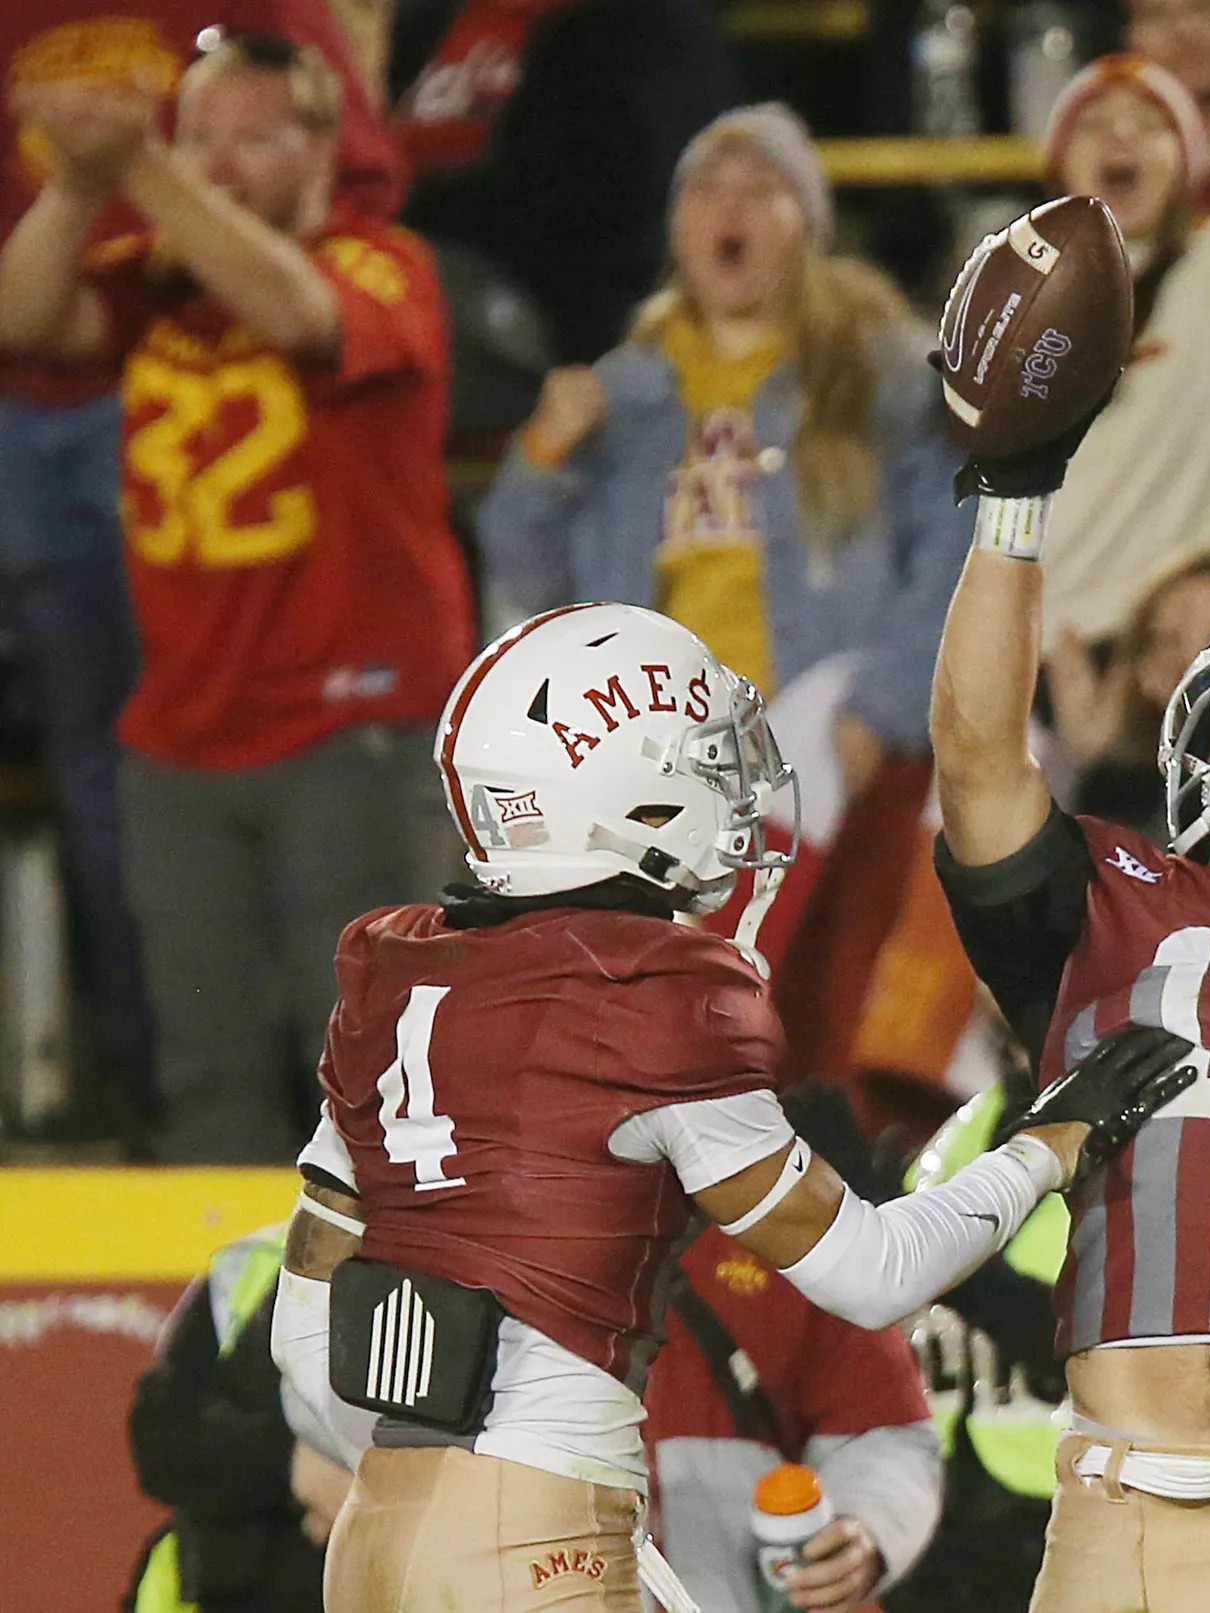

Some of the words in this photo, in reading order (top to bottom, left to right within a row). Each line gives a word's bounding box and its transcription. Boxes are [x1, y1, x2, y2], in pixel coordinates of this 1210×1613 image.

[1020, 328, 1071, 399] TCU
[121, 353, 314, 568] 32
[552, 664, 711, 769] AMES
[472, 784, 506, 846] 4
[376, 985, 467, 1192] 4
[530, 1547, 607, 1586] AMES
